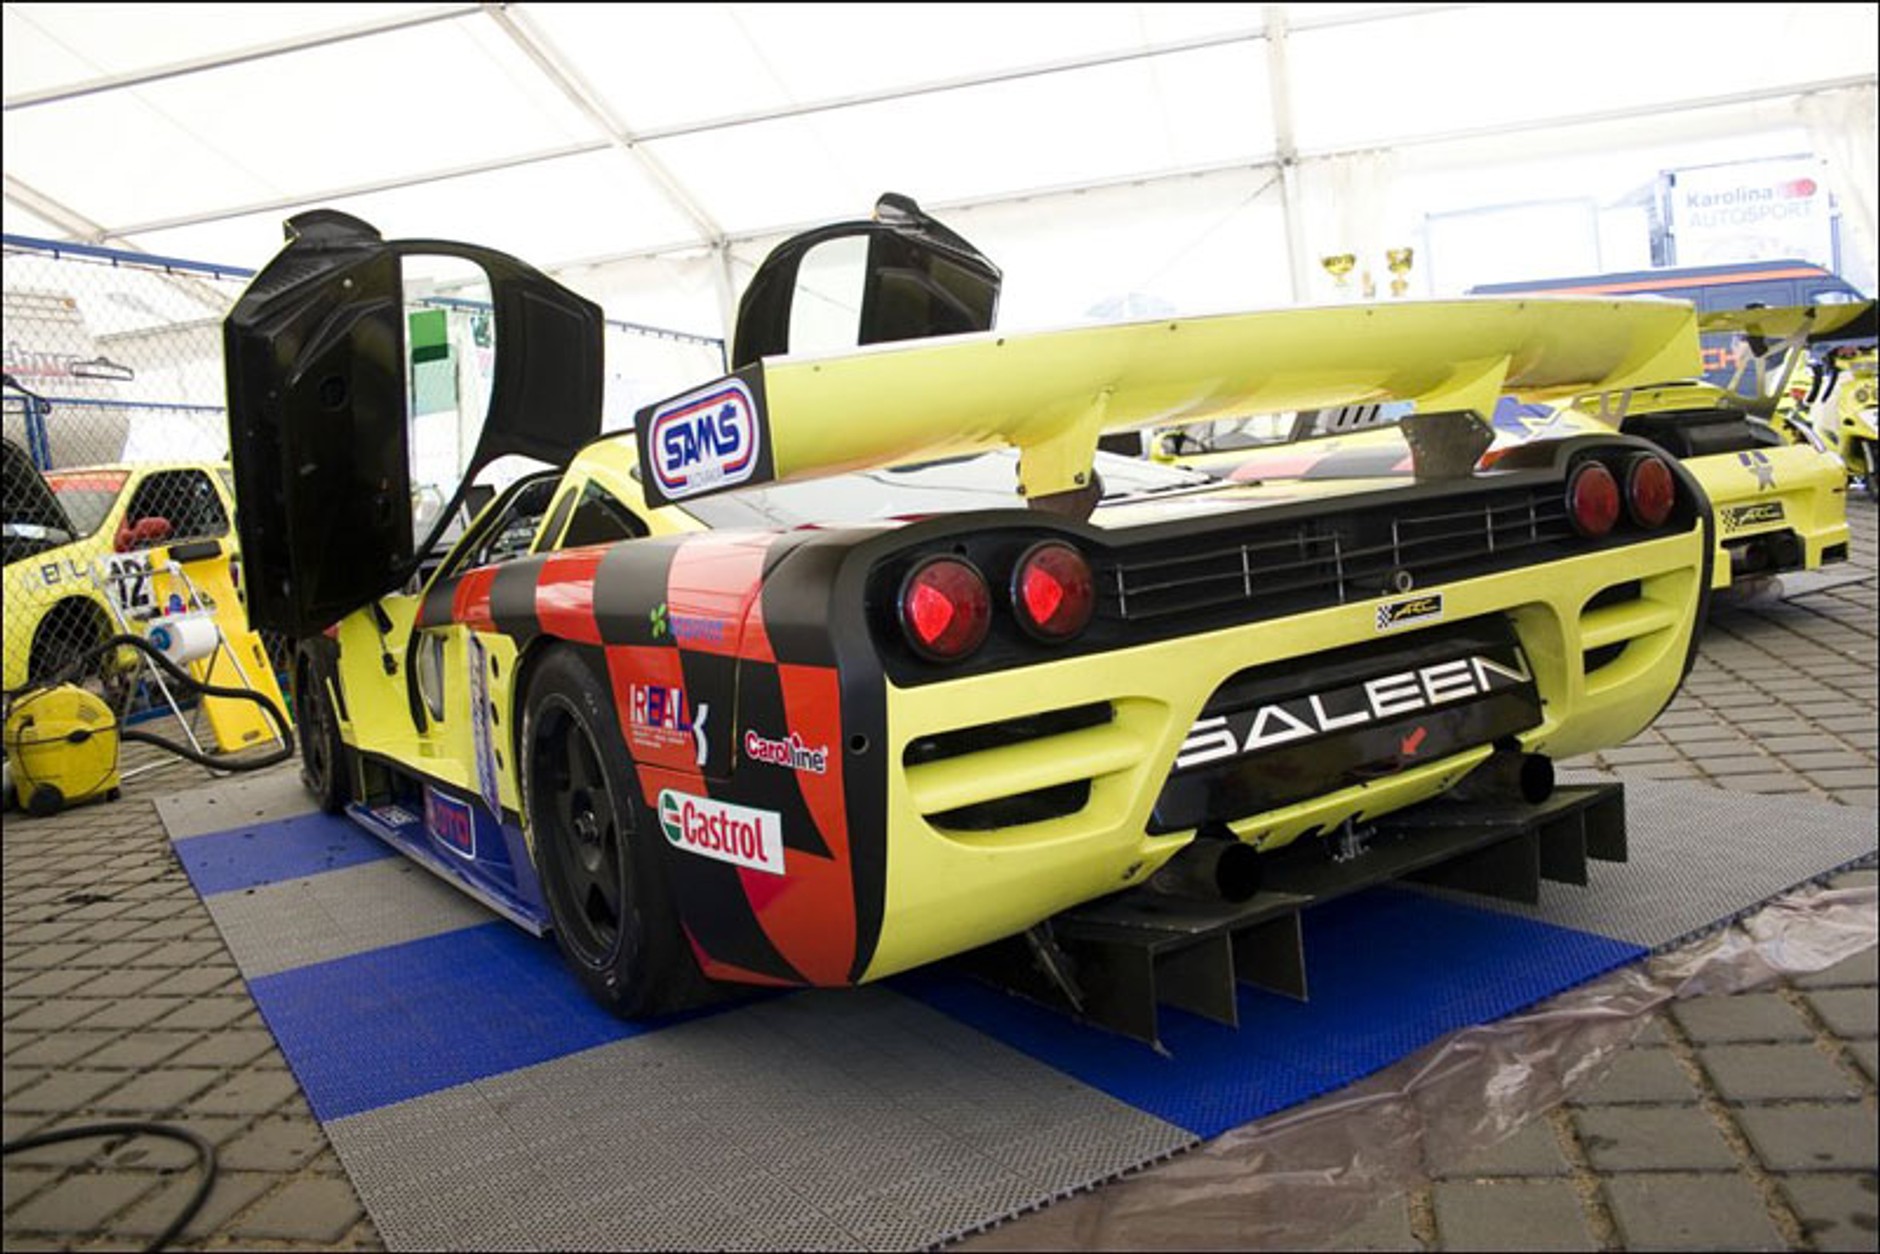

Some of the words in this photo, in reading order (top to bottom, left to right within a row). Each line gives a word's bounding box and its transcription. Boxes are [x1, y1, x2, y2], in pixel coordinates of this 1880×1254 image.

[1686, 187, 1774, 209] Karolina
[1690, 202, 1813, 228] AUTOSPORT
[1177, 647, 1532, 768] SALEEN
[683, 801, 767, 863] Castrol
